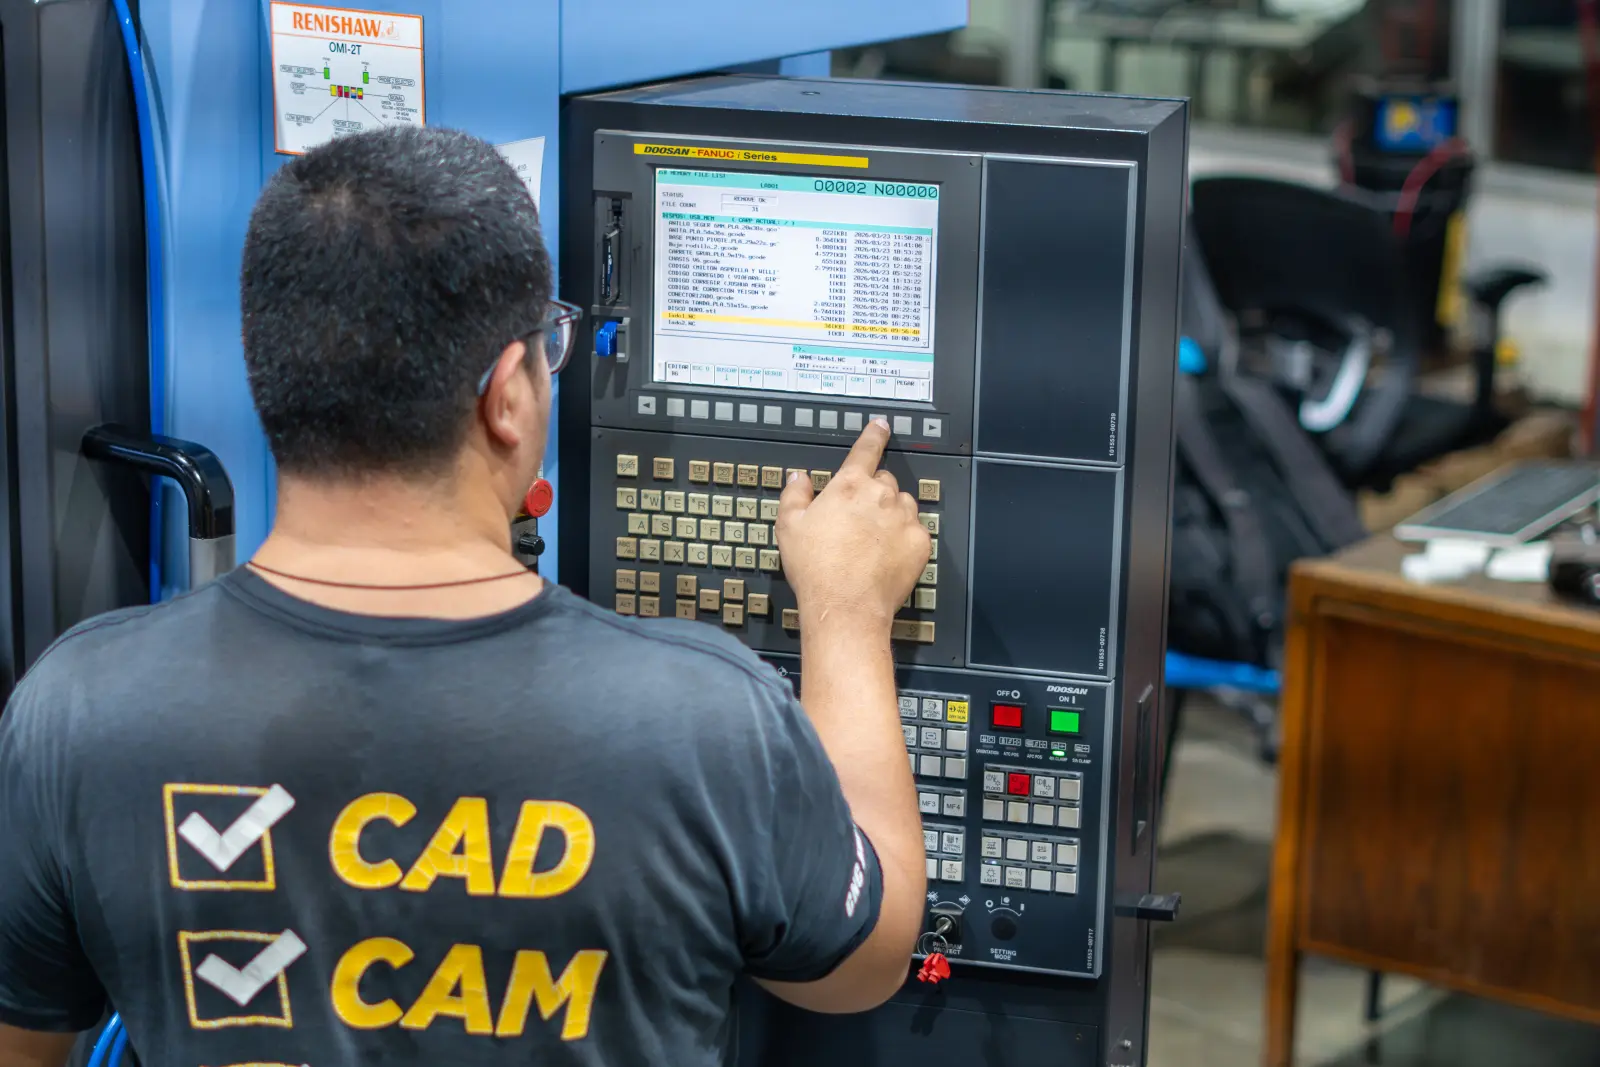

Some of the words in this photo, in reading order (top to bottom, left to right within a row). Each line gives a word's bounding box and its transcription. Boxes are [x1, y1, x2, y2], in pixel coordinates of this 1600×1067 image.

[293, 11, 381, 39] RENISHAW
[328, 41, 362, 56] OMI-2T
[643, 146, 690, 156] DOOSAN
[697, 148, 735, 159] FANUC
[743, 152, 778, 161] Series
[874, 184, 938, 198] N00000
[626, 495, 634, 504] Q
[650, 497, 660, 506] W
[674, 499, 682, 508] E
[698, 501, 706, 510] R
[722, 504, 731, 512] T
[747, 505, 756, 514] Y
[770, 508, 778, 517] U
[638, 521, 646, 530] A
[661, 523, 670, 532] S
[928, 521, 936, 531] 9
[686, 526, 694, 535] D
[710, 528, 718, 537] F
[734, 530, 742, 539] G
[758, 531, 766, 540] H
[649, 547, 658, 557] Z
[674, 549, 682, 558] X
[697, 552, 706, 561] C
[721, 554, 730, 563] V
[745, 556, 753, 565] B
[769, 558, 778, 568] N
[926, 572, 934, 581] 3
[996, 690, 1010, 698] OFF
[1046, 686, 1088, 696] DOOSAN
[921, 800, 936, 808] MF3
[946, 802, 961, 810] MF4
[328, 791, 597, 900] CAD
[990, 948, 1017, 956] SETTING
[329, 936, 609, 1041] CAM
